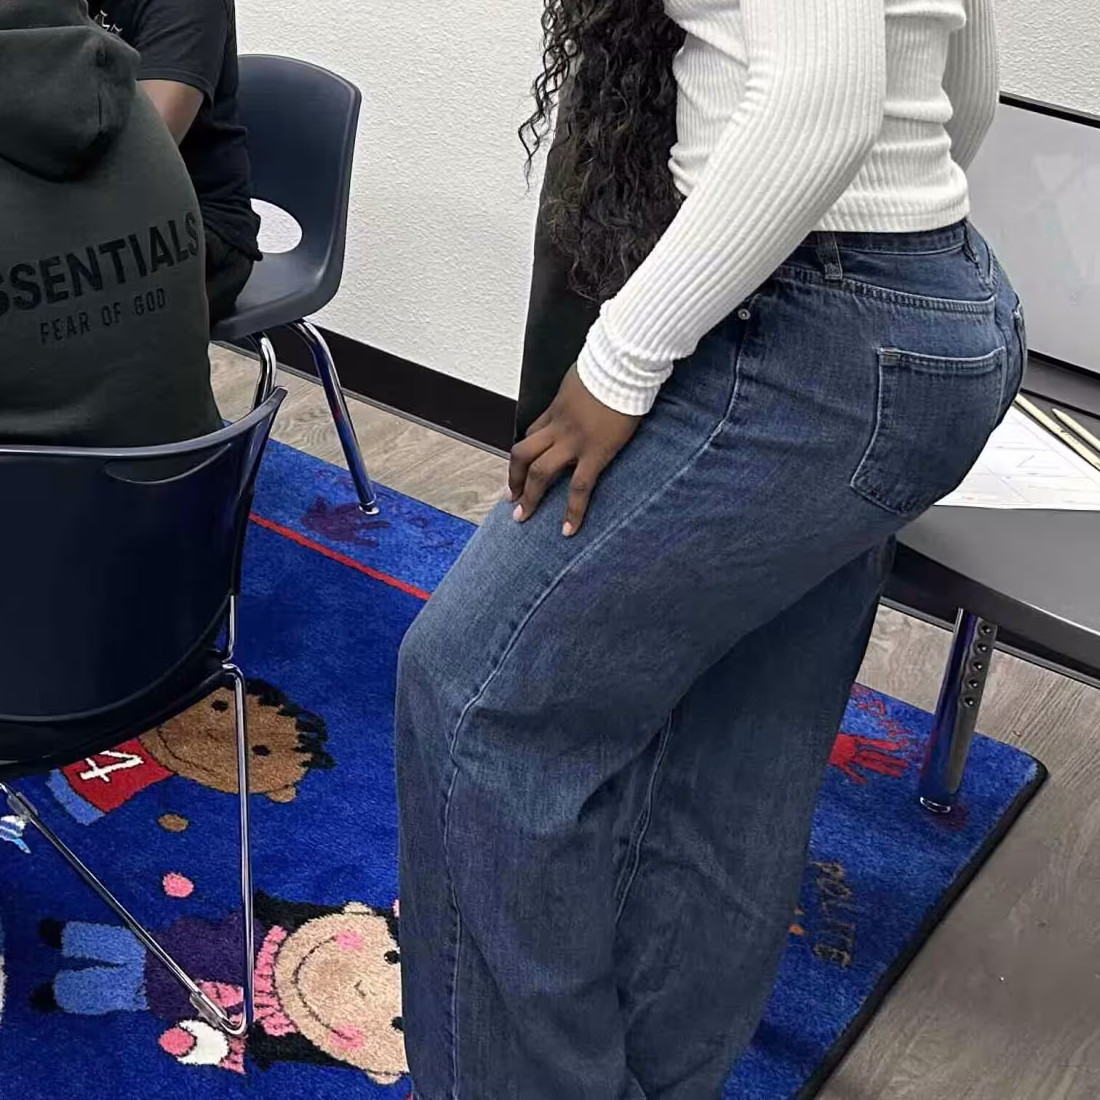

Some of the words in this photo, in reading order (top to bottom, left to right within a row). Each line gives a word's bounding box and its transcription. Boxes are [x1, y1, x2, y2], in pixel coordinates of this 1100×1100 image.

[39, 311, 90, 344] FEAR
[101, 302, 122, 328] OF
[133, 287, 166, 316] GOD
